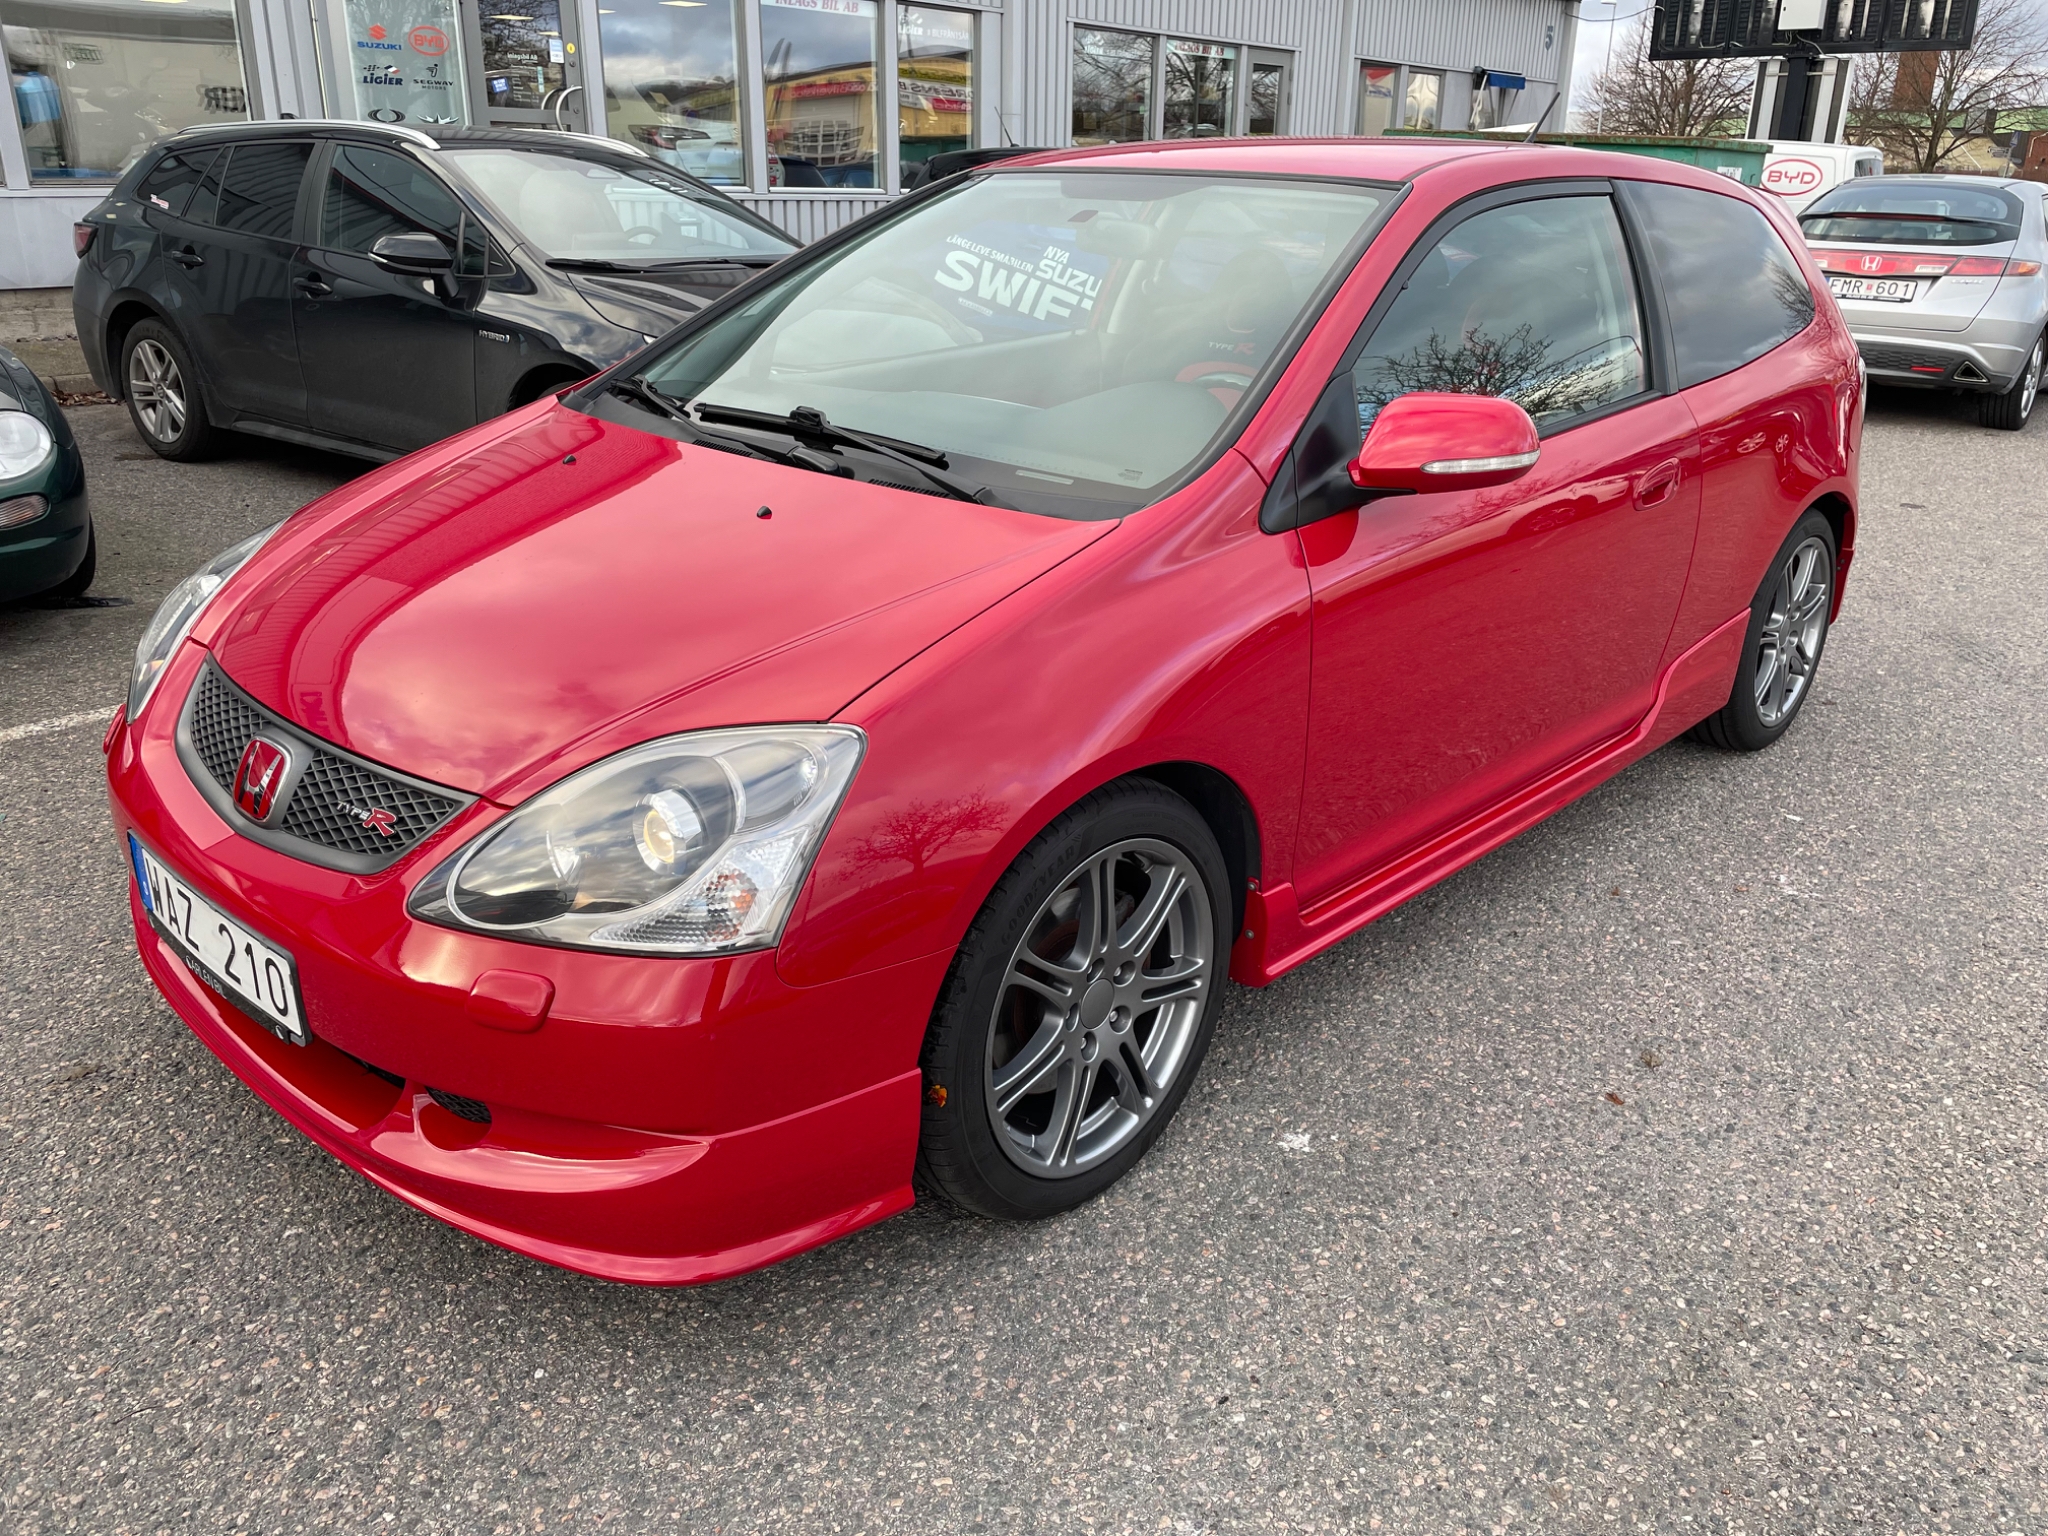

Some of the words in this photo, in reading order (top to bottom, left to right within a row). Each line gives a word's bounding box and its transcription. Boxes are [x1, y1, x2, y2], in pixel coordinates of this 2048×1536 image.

[822, 0, 840, 11] BIL
[843, 1, 859, 13] AB
[357, 41, 402, 51] SUZUKI
[413, 34, 445, 48] BYD
[363, 73, 403, 86] LIGIER
[413, 79, 454, 87] SEGWAY
[1767, 170, 1815, 184] BYD
[946, 234, 972, 251] LÄNGE
[971, 243, 992, 257] LEVE
[1043, 246, 1070, 264] NYA
[1035, 259, 1102, 298] SUZU
[1830, 279, 1863, 294] FMR
[1876, 281, 1910, 297] 601
[479, 330, 505, 342] HYBRID
[1209, 342, 1234, 351] TYPE
[1233, 343, 1255, 355] R
[336, 800, 371, 821] TYPE
[363, 807, 399, 837] R
[1001, 845, 1076, 945] GOODYEAR
[144, 856, 200, 953] WAZ
[218, 922, 289, 1018] 210
